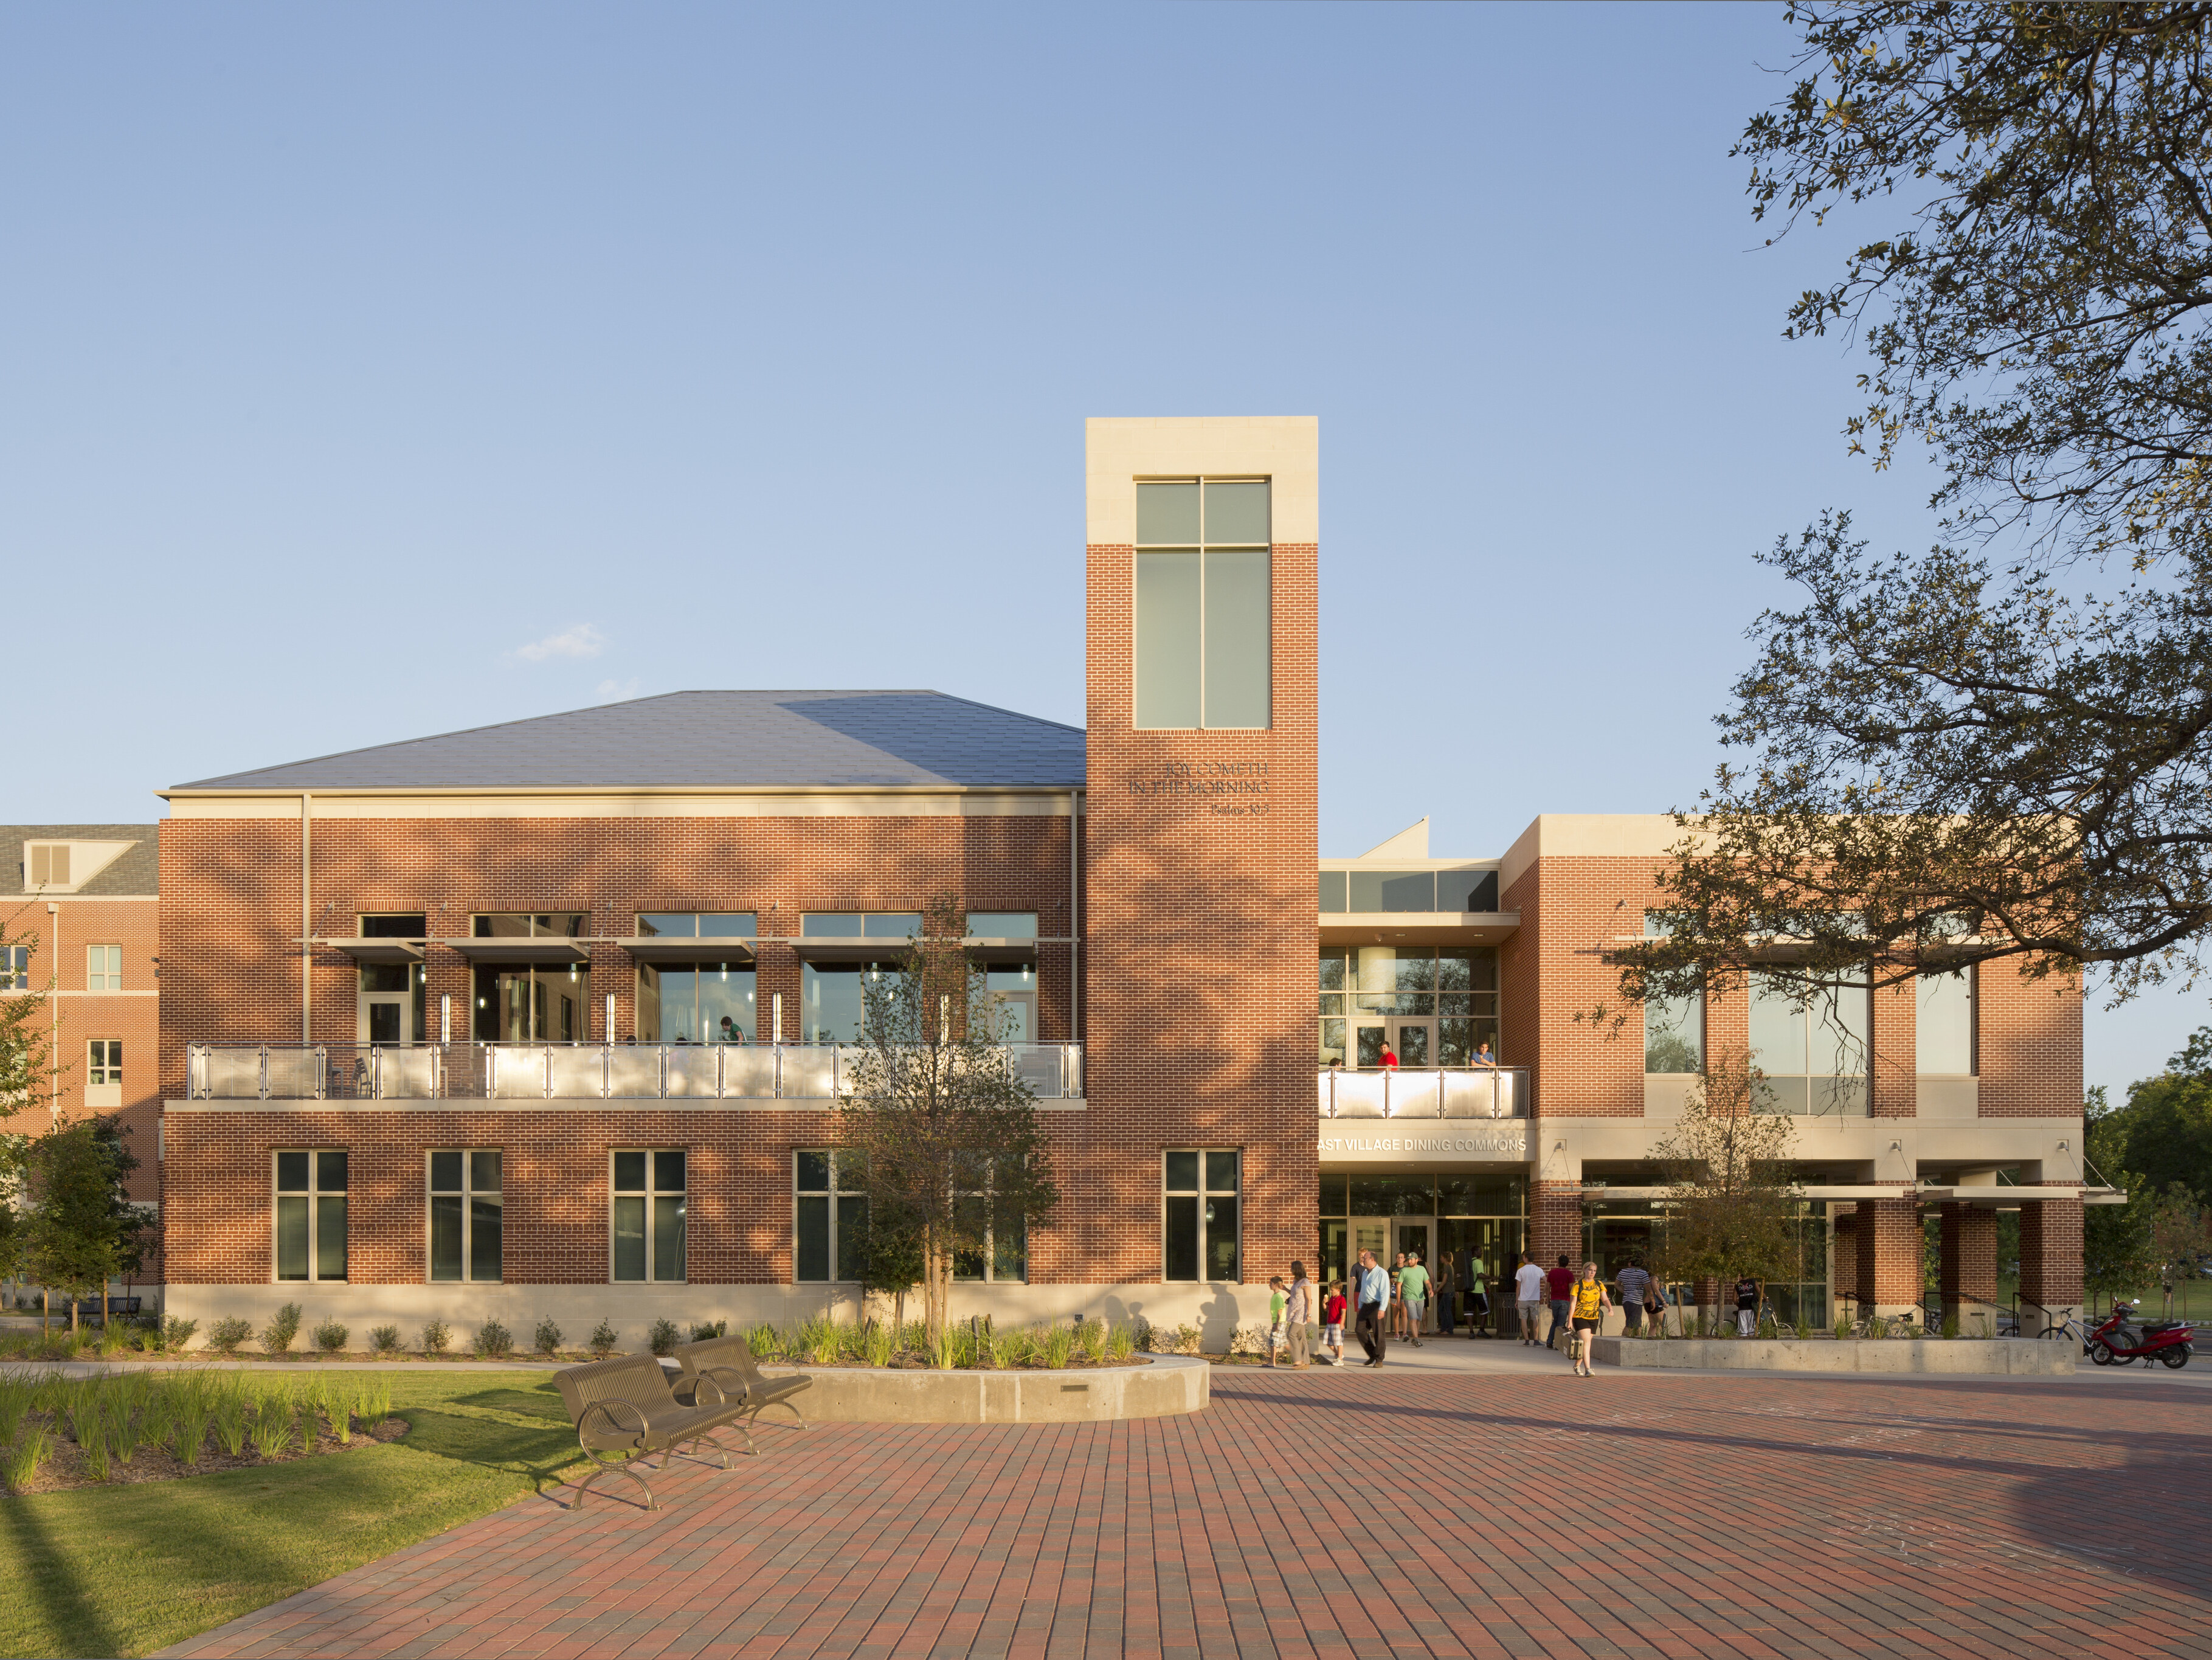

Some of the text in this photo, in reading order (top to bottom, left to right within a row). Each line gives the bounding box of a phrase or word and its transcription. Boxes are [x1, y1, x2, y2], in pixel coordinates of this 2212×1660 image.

[1165, 763, 1268, 778] JOY COMETH
[1129, 781, 1269, 794] IN THE MORNING
[1211, 804, 1245, 814] Psalms
[1344, 1139, 1400, 1150] VILLAGE
[1403, 1139, 1451, 1151] DINING
[1455, 1139, 1527, 1151] COMMONS
